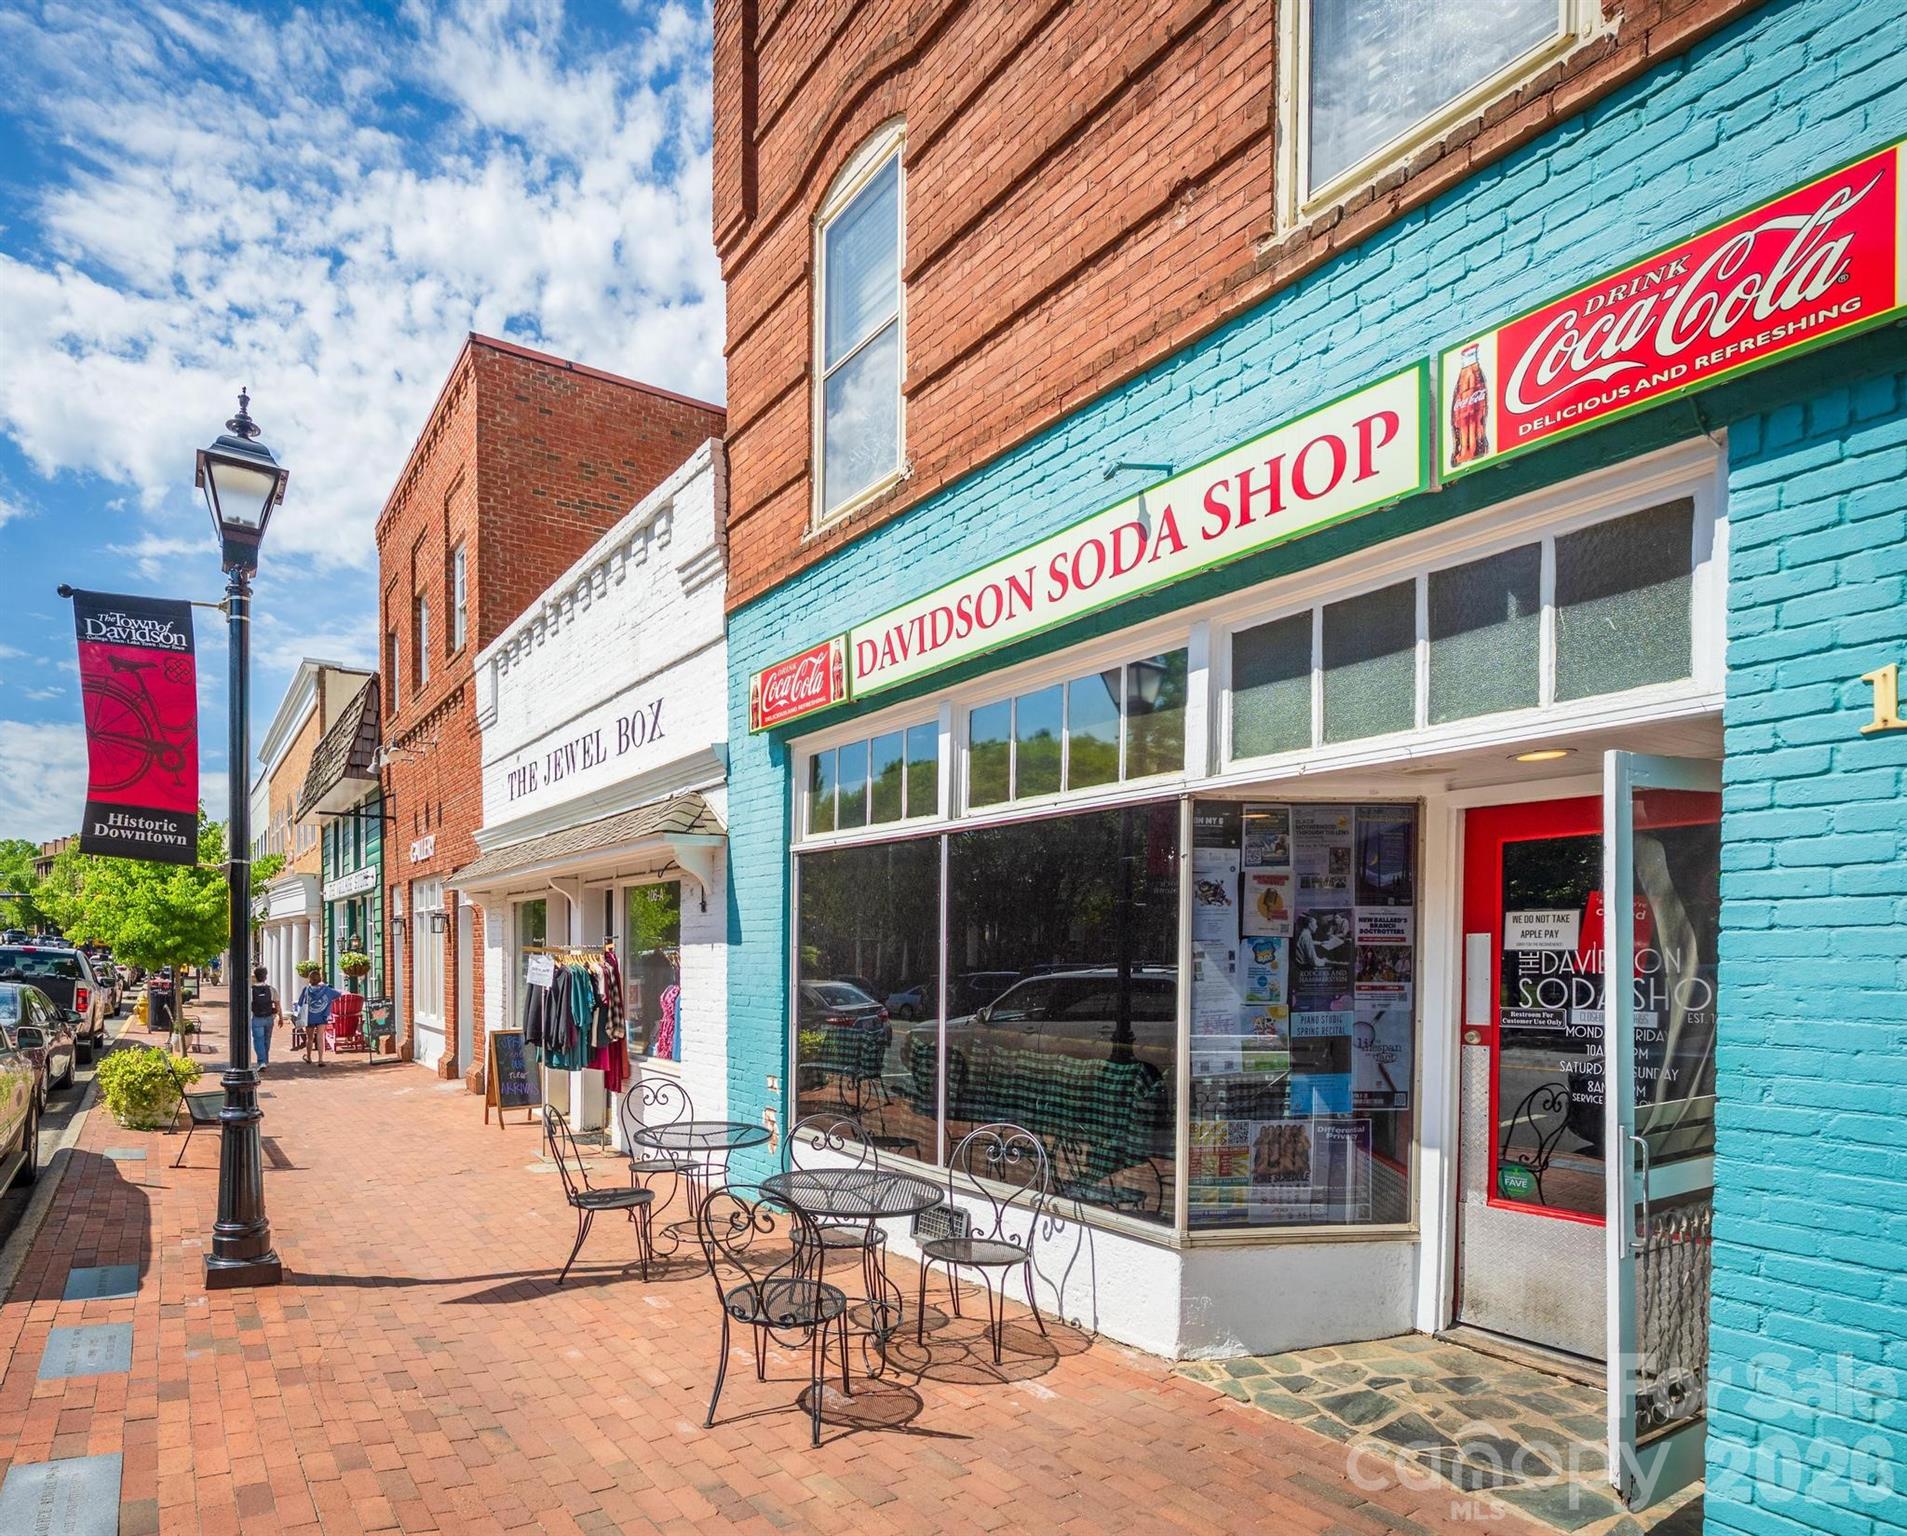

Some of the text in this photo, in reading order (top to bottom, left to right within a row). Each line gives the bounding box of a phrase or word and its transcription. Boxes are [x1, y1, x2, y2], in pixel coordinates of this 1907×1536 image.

[1504, 168, 1886, 415] Coca-Cola
[1583, 254, 1695, 318] DRINK
[1518, 296, 1863, 436] DELICIOUS AND REFRESHING
[857, 410, 1401, 680] DAVIDSON SODA SHOP
[84, 617, 188, 648] Davidson
[109, 611, 158, 630] Town
[157, 621, 174, 636] of
[762, 651, 828, 713] Coca-Cola
[507, 697, 665, 801] THE JEWEL BOX
[94, 823, 188, 846] Downtown
[108, 812, 178, 834] Historic
[1513, 914, 1570, 923] WE DO NOT TAKE
[1521, 930, 1559, 938] APPLE PAY
[1519, 942, 1680, 975] THE DAVION
[1301, 1015, 1320, 1024] PIANO
[1510, 1010, 1554, 1019] Restroom For
[1297, 1025, 1345, 1035] SPRING RECITAL
[1572, 1093, 1603, 1104] SERVICE
[1317, 1126, 1365, 1134] Differential
[1504, 1178, 1528, 1188] FAVE
